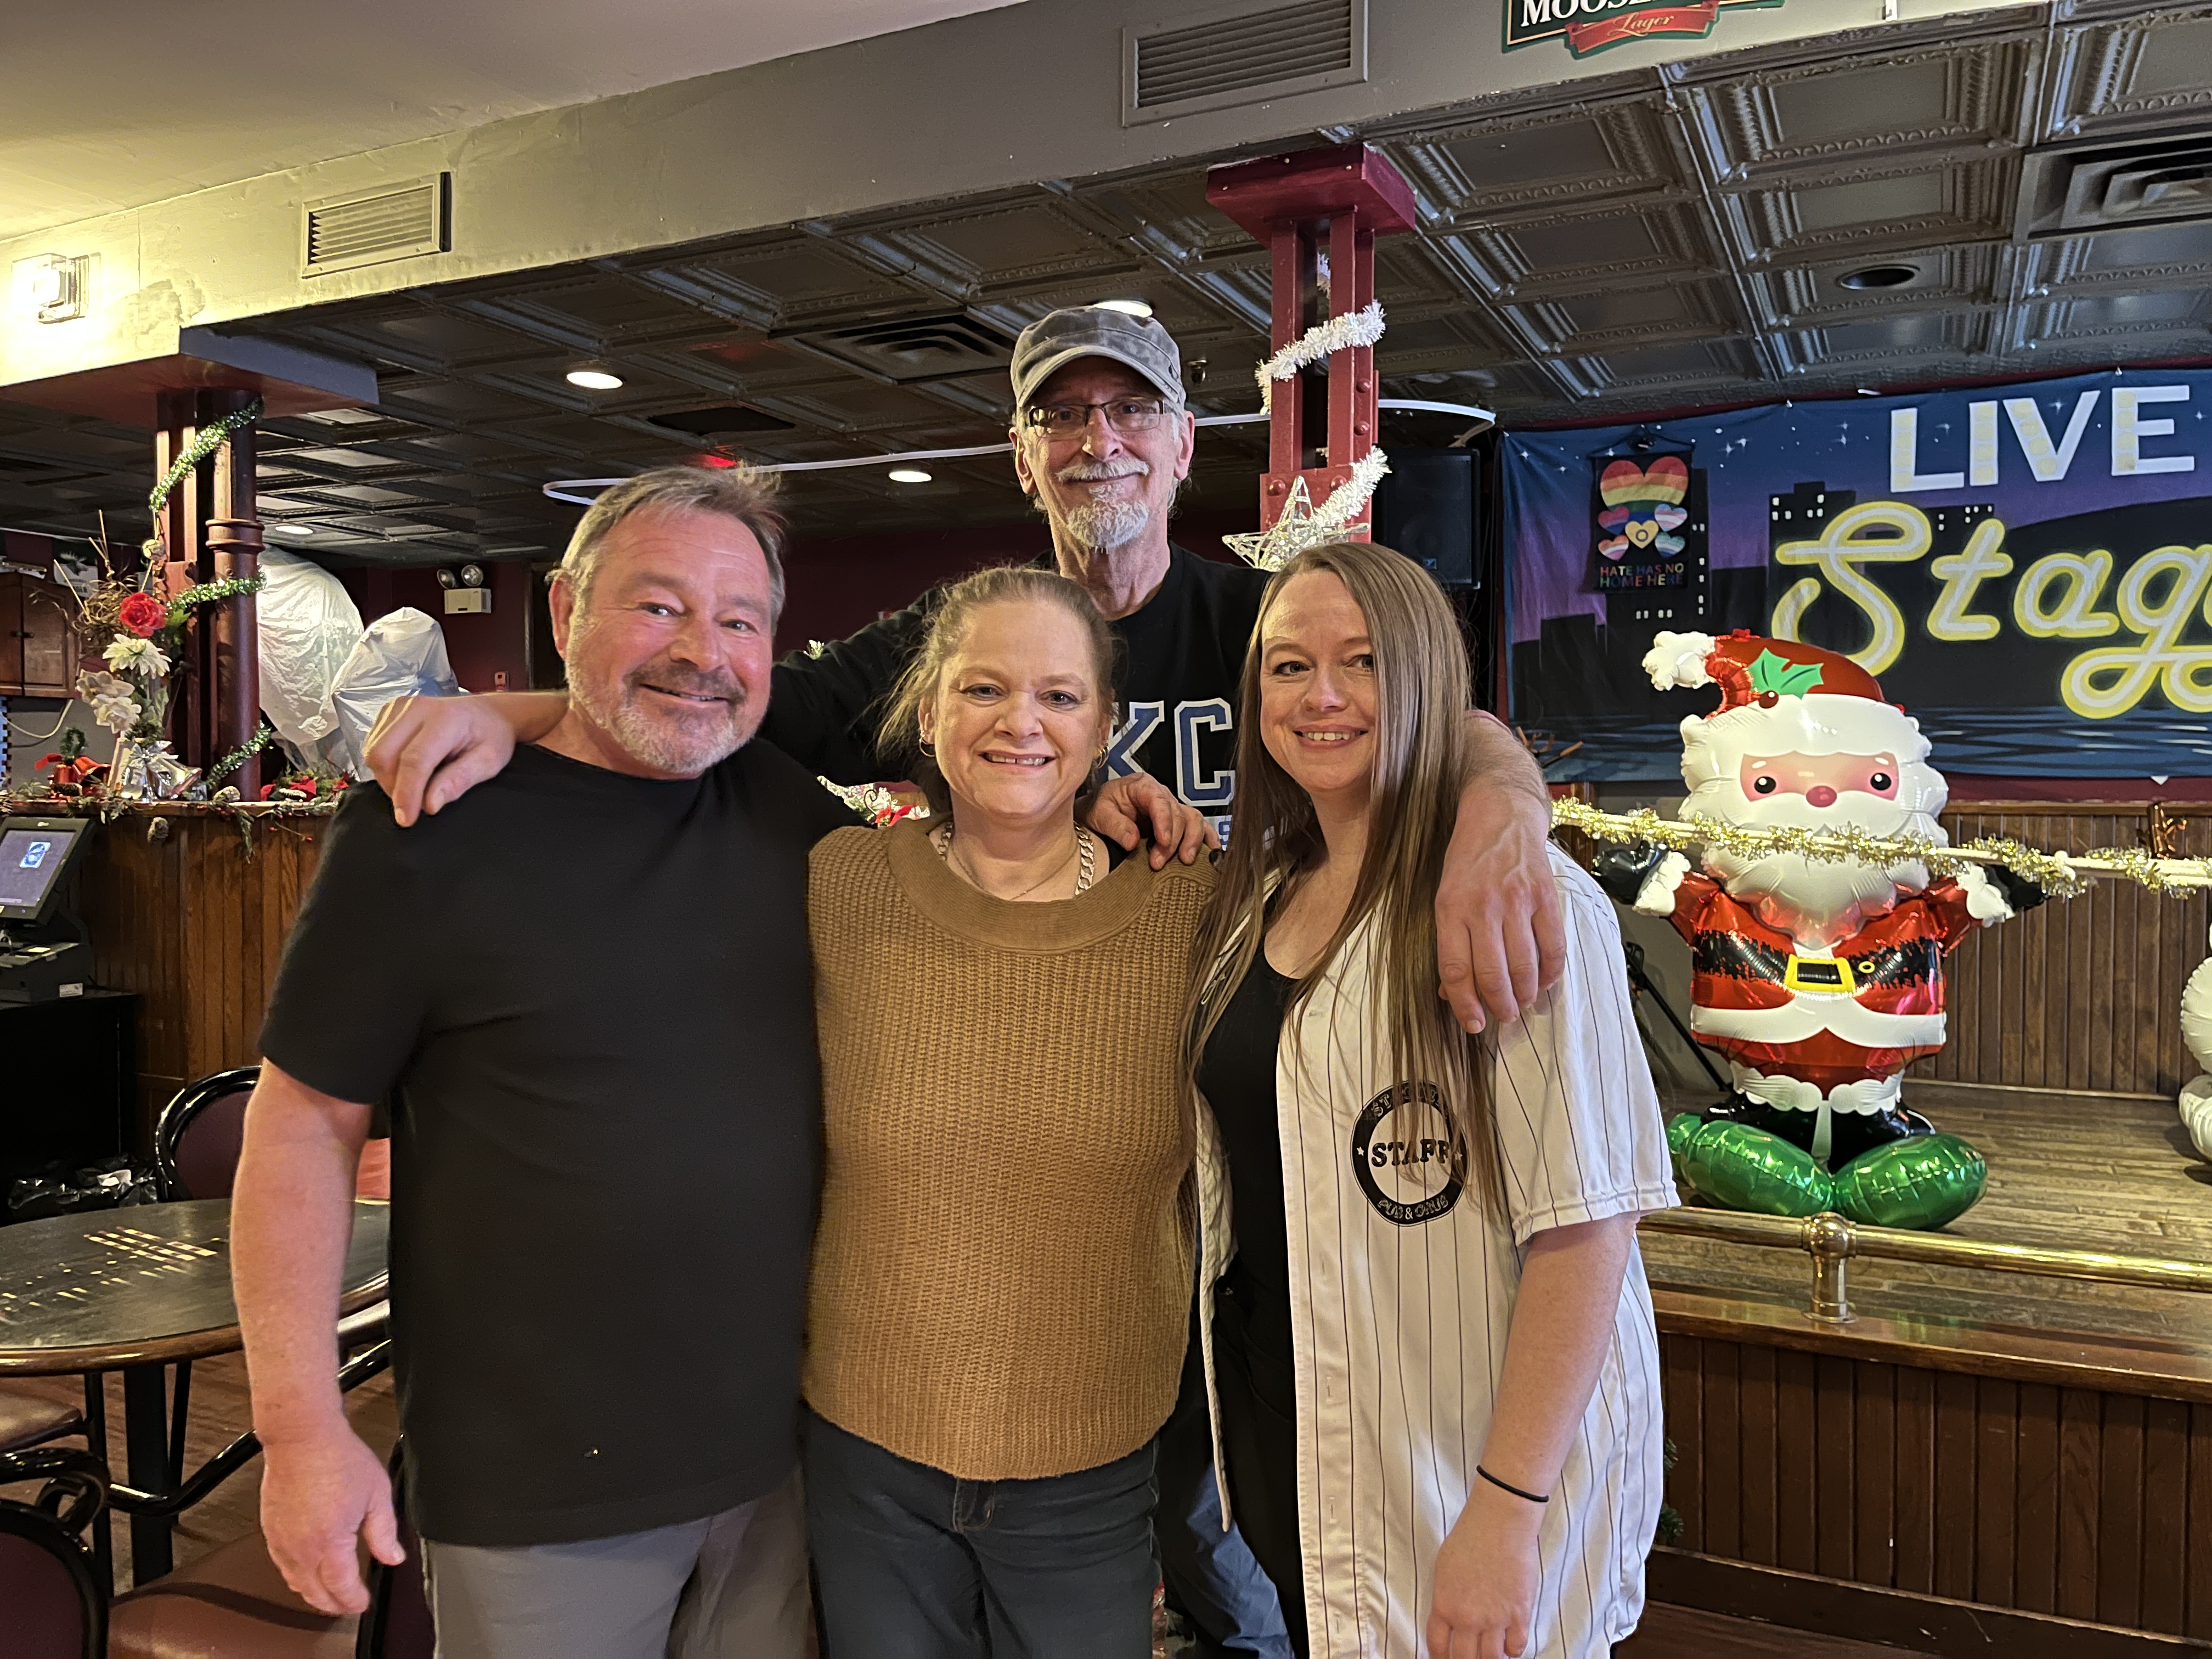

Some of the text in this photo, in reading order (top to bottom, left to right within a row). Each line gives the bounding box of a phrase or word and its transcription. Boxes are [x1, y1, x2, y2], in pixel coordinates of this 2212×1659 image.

[1607, 12, 1674, 37] Lager
[1891, 385, 2194, 493] LIVE
[1600, 562, 1684, 577] HATE HAS NO
[1600, 573, 1684, 588] HOME HERE
[1772, 500, 2212, 719] Stag
[1372, 1138, 1449, 1167] STAFF
[1377, 1195, 1448, 1220] PUB & GRUB
